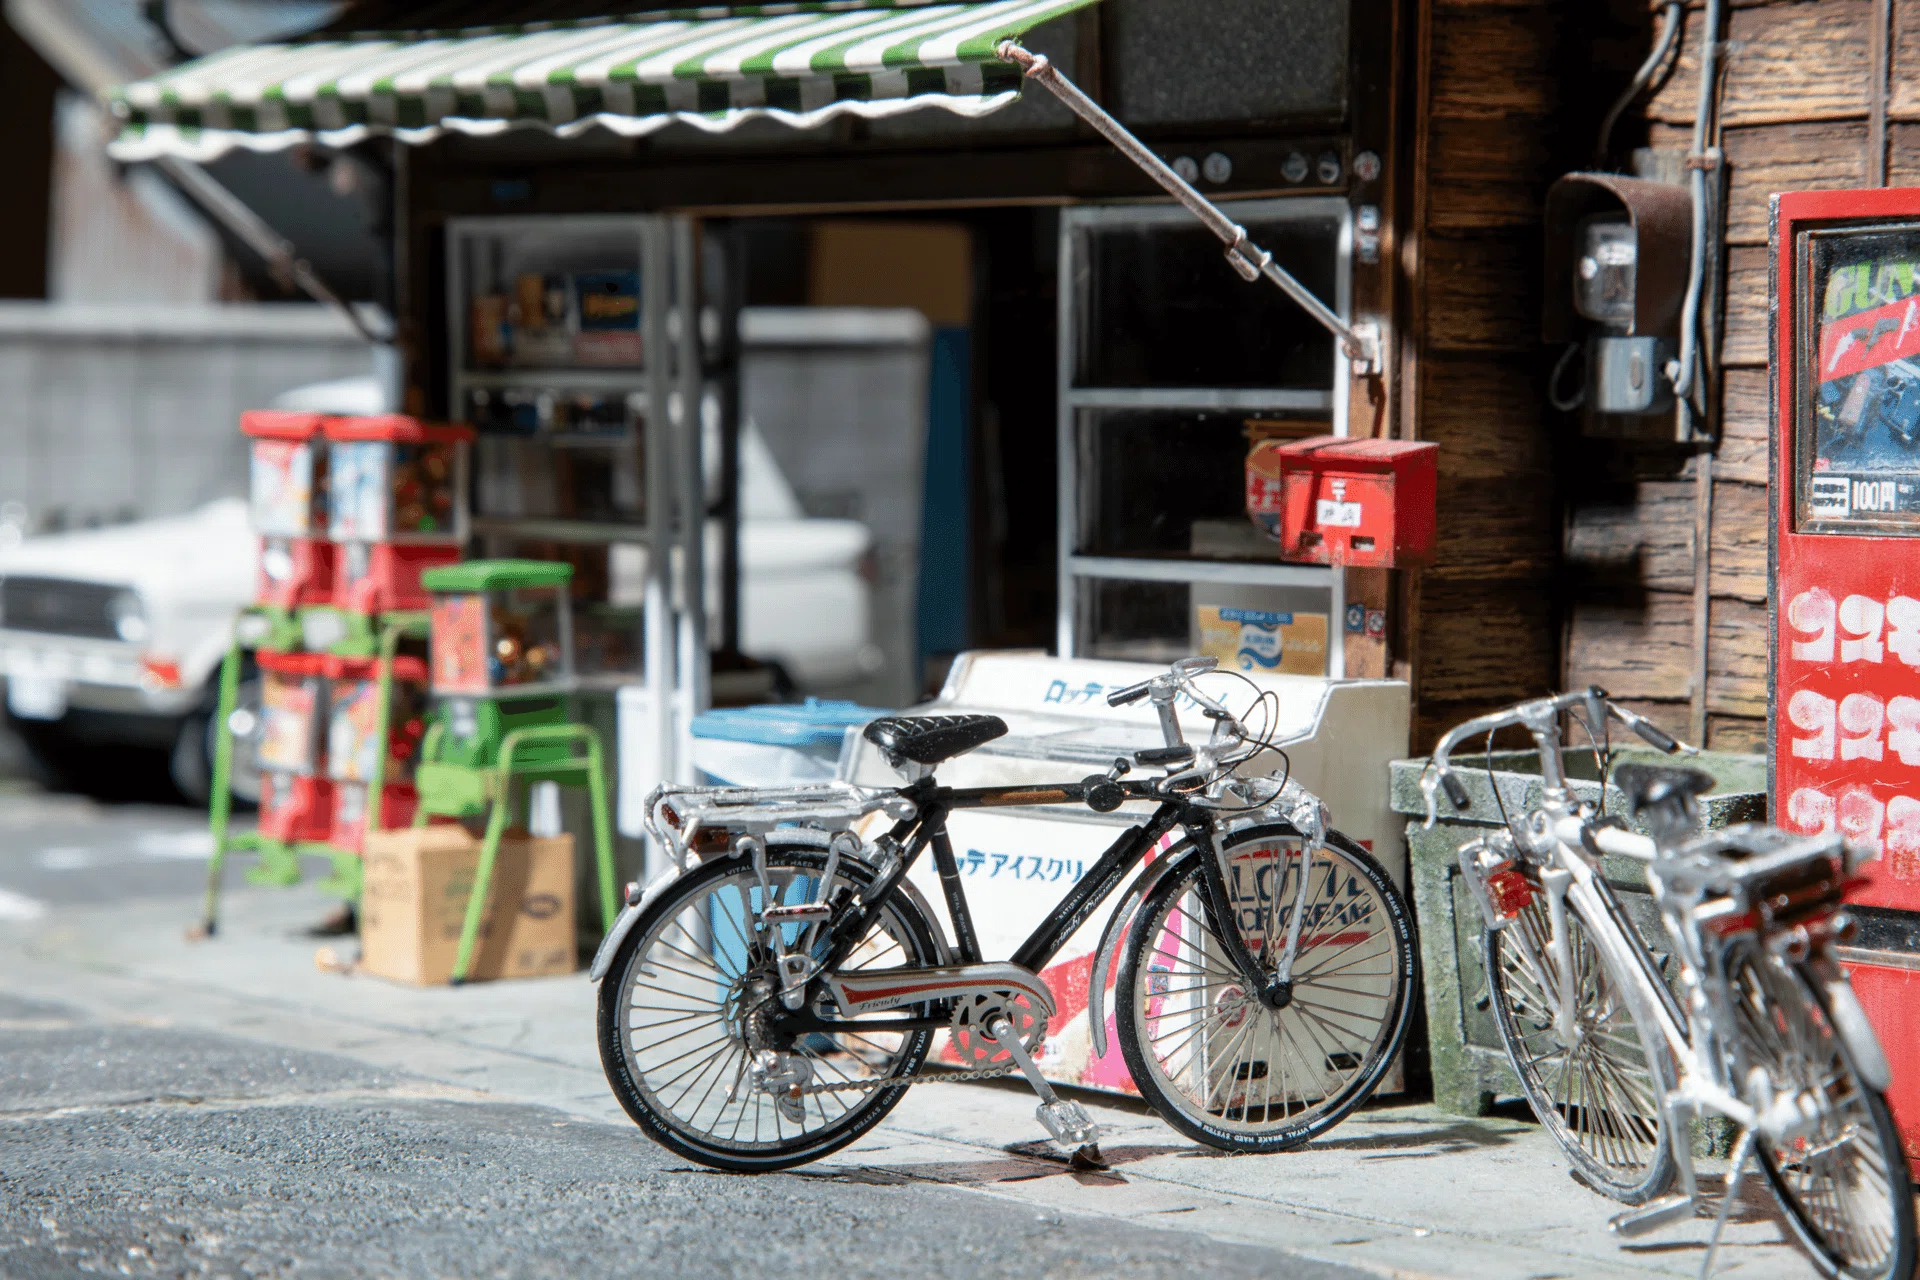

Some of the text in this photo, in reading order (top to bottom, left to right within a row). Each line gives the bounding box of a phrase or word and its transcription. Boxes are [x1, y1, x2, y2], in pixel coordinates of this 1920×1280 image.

[1852, 481, 1896, 511] 100円
[1369, 869, 1386, 891] VITAL
[1385, 891, 1401, 917] BRAKE
[901, 1057, 917, 1079] BRAK
